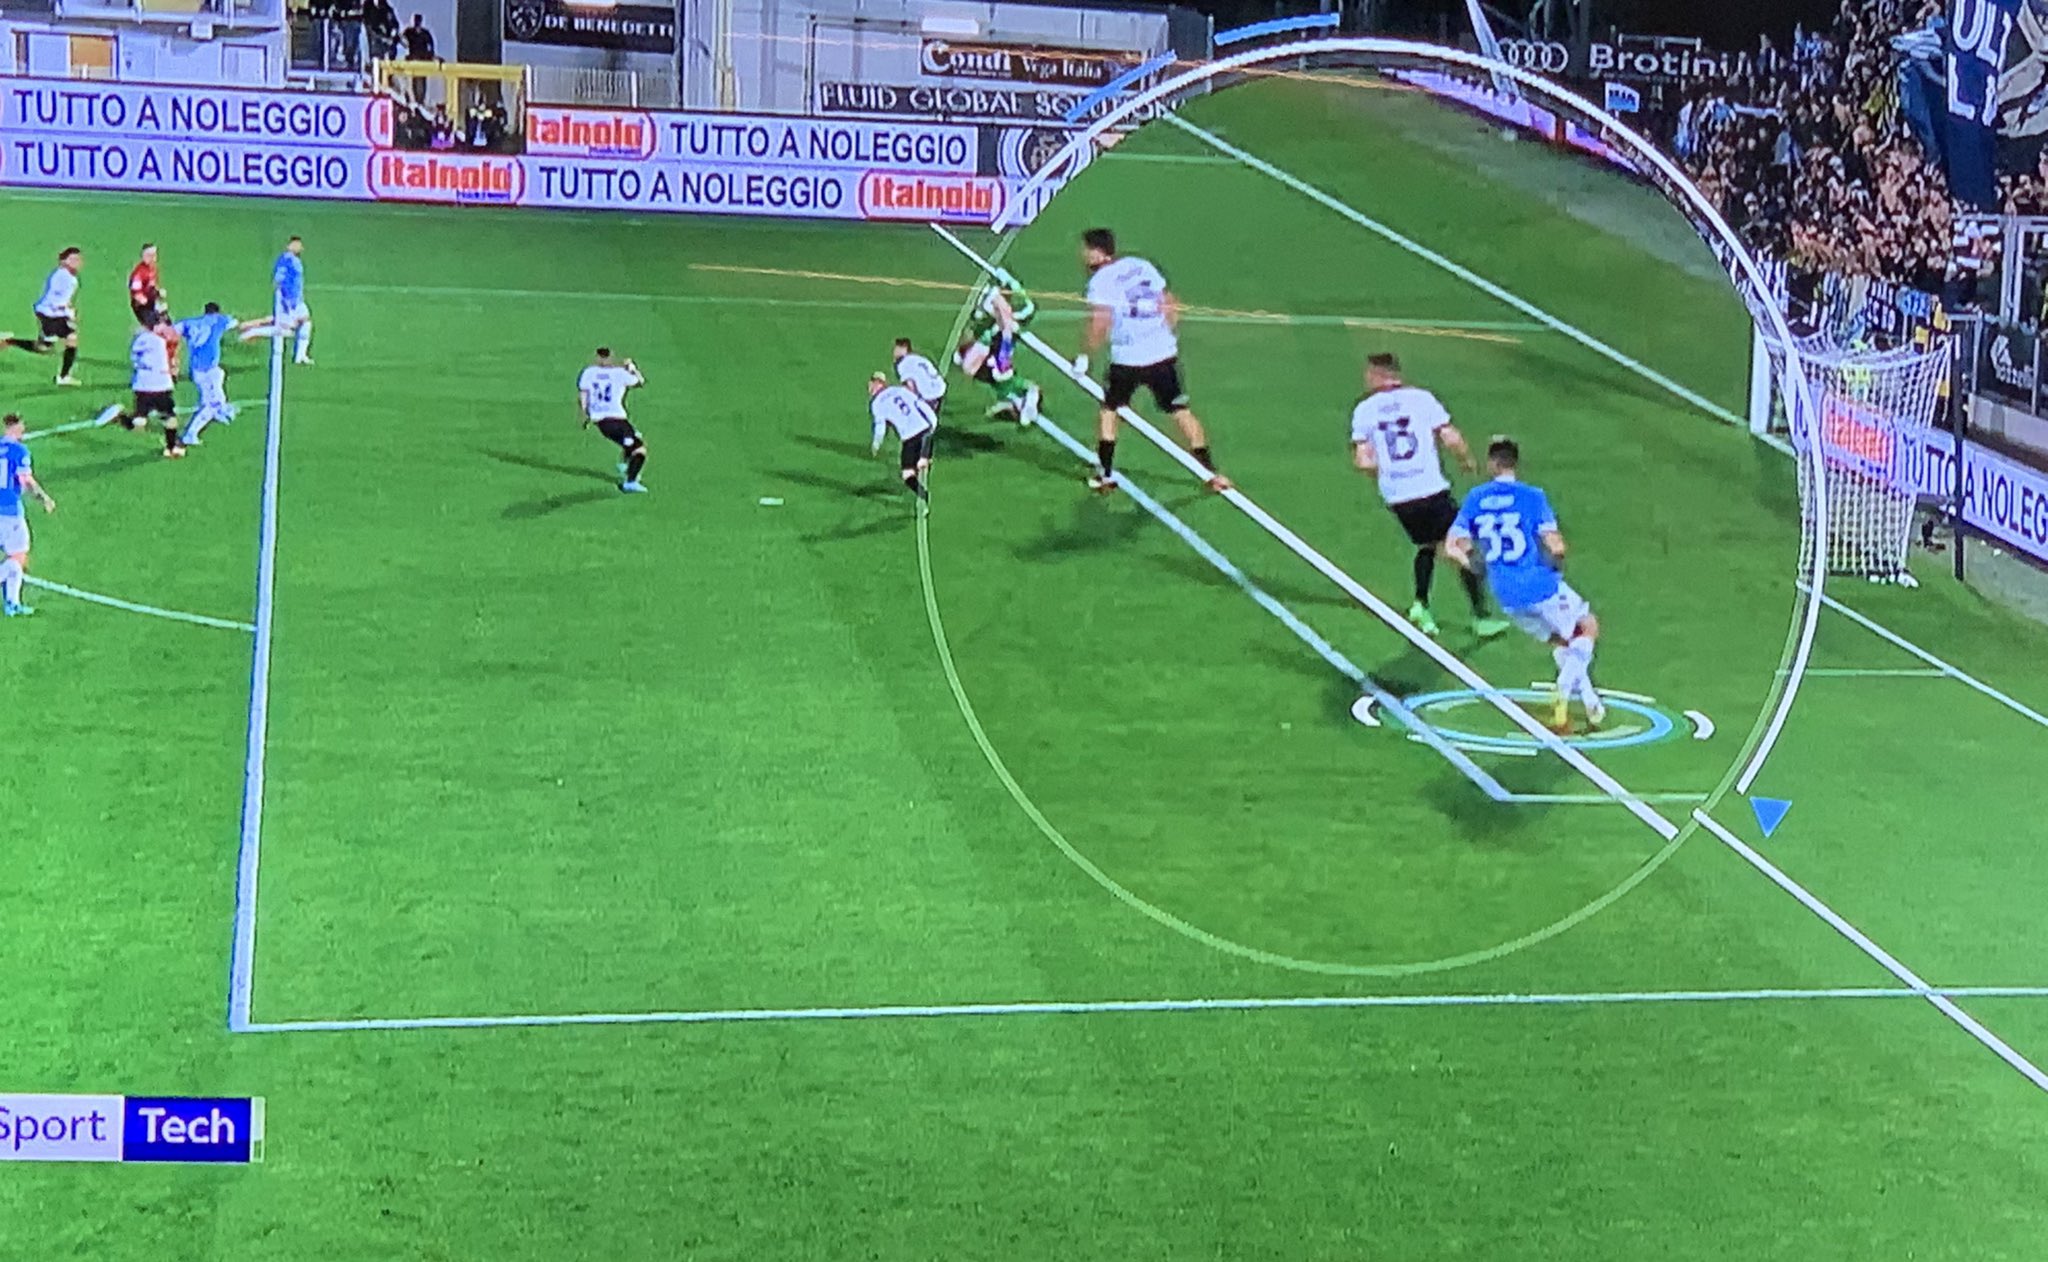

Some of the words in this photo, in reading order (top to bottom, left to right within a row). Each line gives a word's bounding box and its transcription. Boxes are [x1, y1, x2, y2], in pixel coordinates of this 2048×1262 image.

[1589, 43, 1729, 78] Brotini
[13, 90, 126, 127] TUTTO
[136, 94, 160, 131] A
[172, 96, 346, 138] NOLEGGIO
[15, 141, 128, 179] TUTTO
[138, 147, 161, 180] A
[173, 148, 348, 189] NOLEGGIO
[671, 122, 769, 157] TUTTO
[779, 127, 799, 159] A
[810, 127, 966, 166] NOLEGGIO
[540, 166, 640, 201] TUTTO
[650, 171, 672, 202] A
[682, 172, 842, 209] NOLEGGIO
[1964, 461, 1976, 514] A
[1475, 512, 1527, 562] 33
